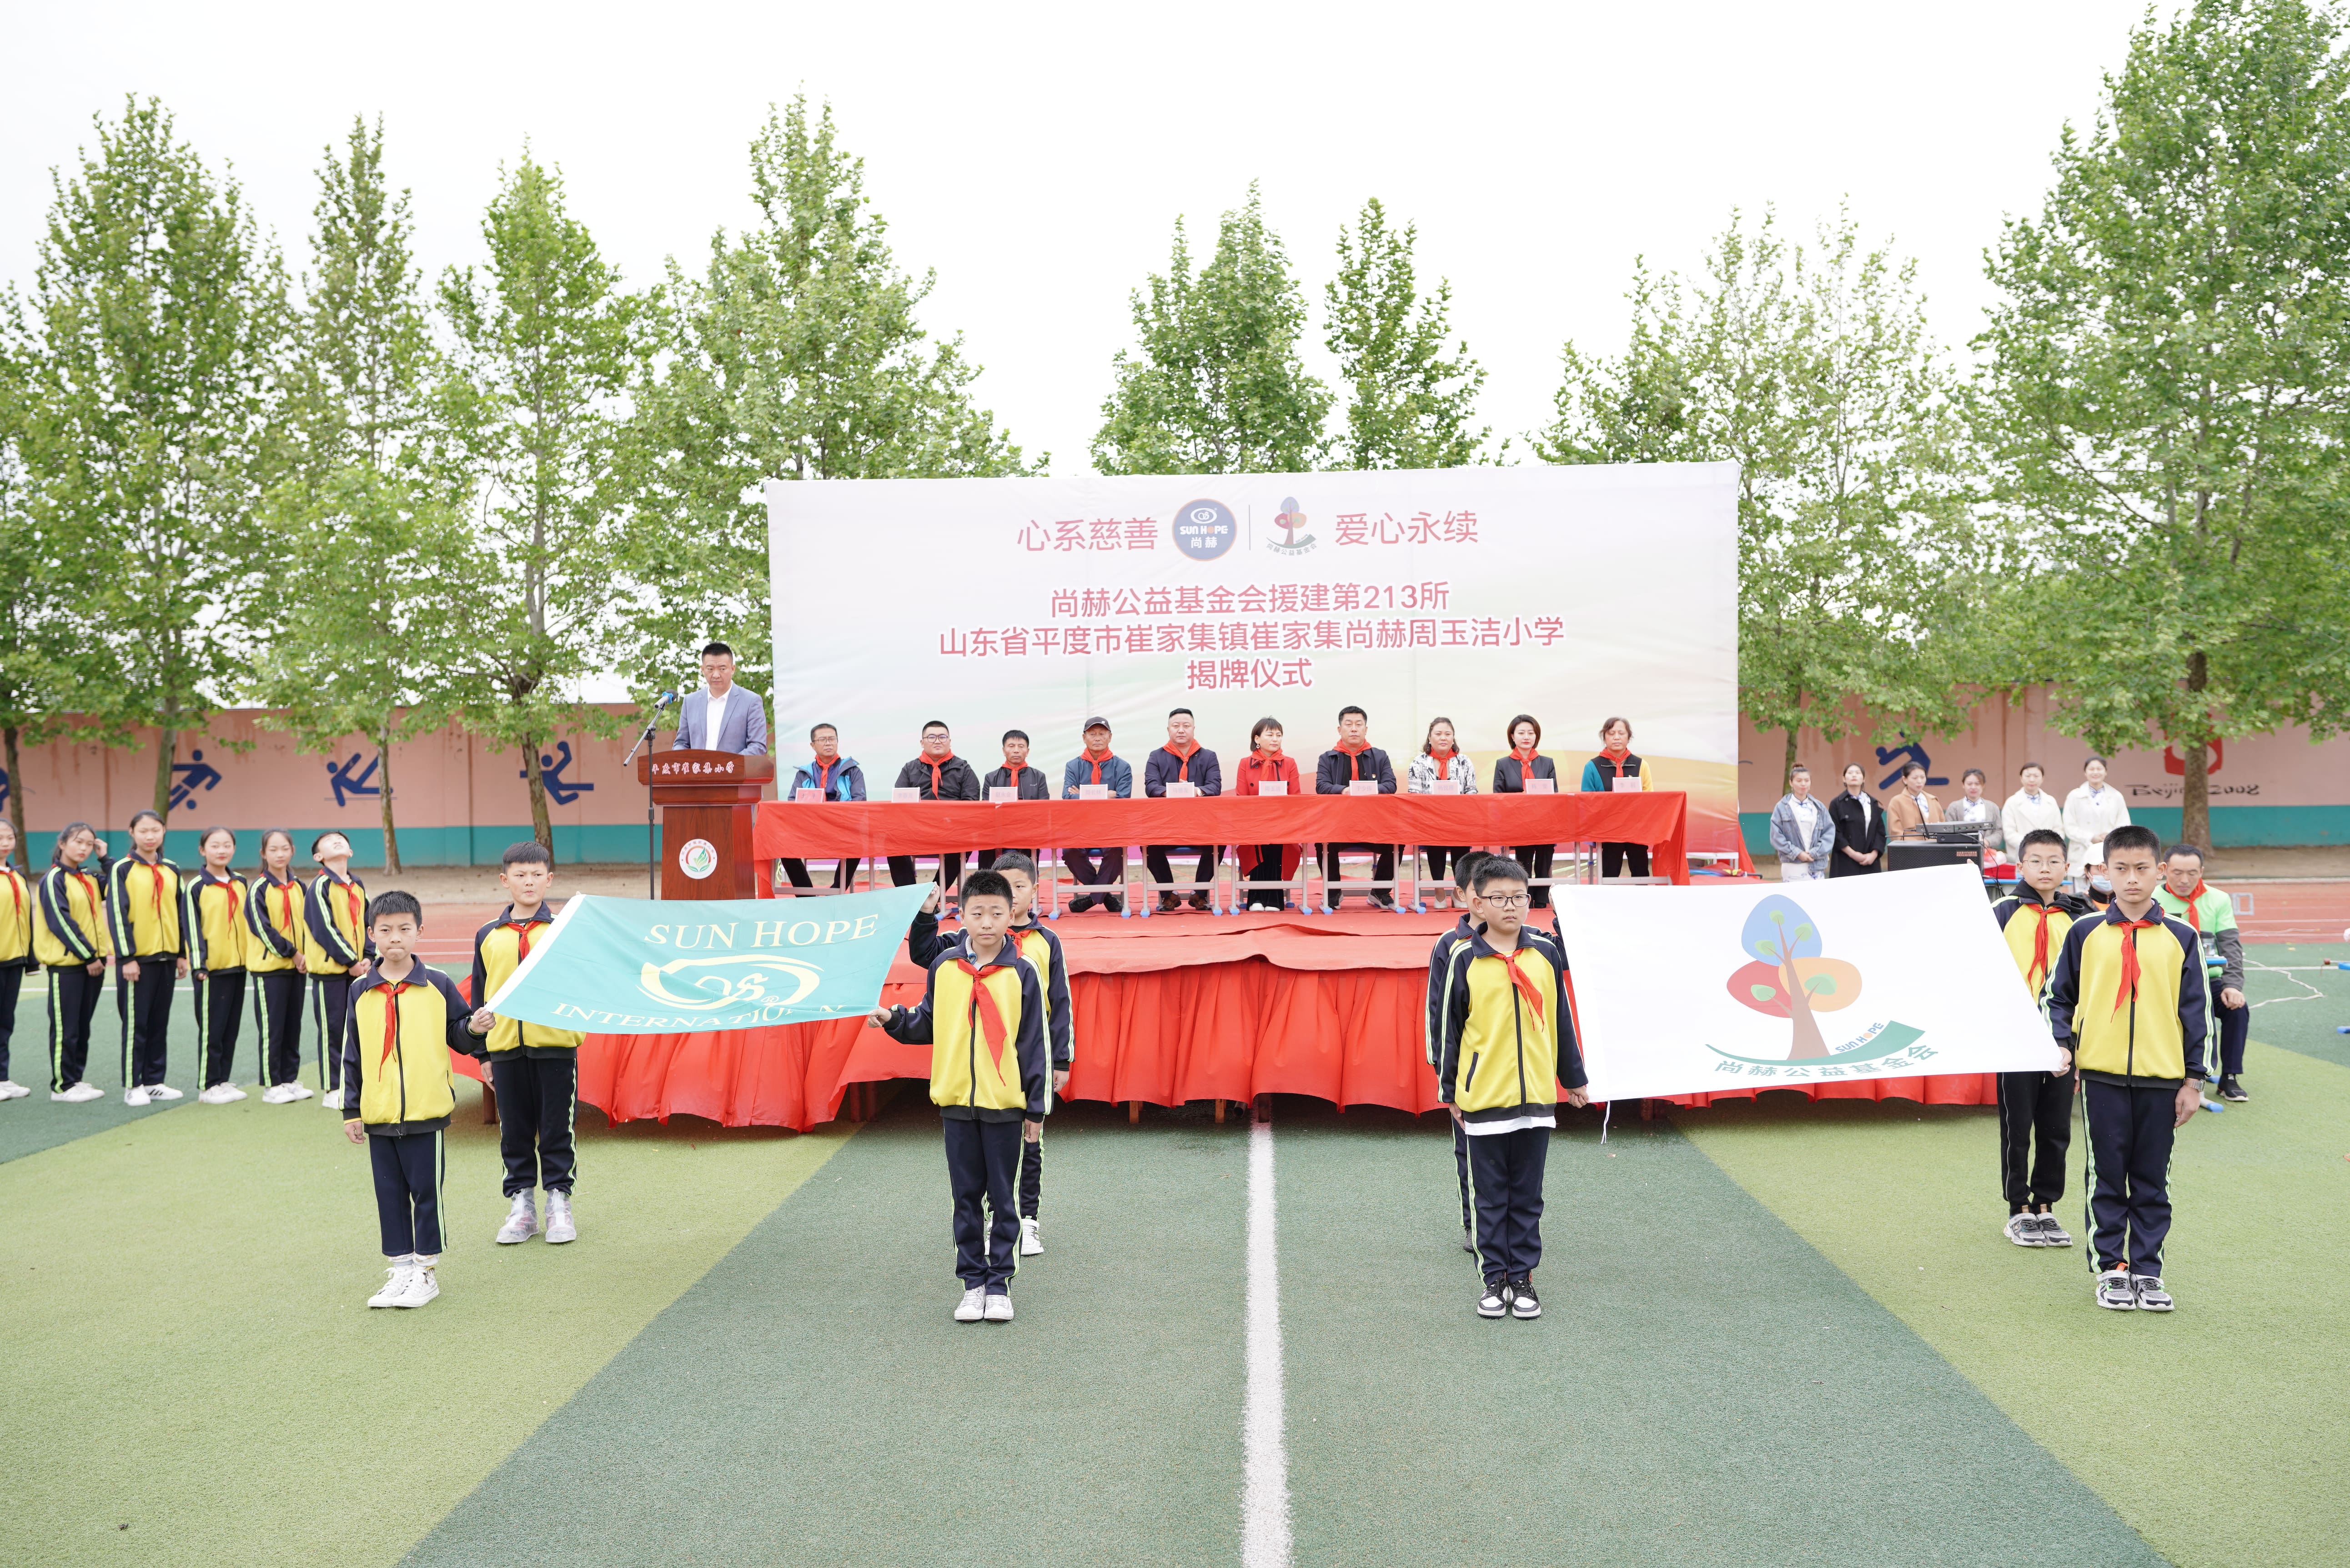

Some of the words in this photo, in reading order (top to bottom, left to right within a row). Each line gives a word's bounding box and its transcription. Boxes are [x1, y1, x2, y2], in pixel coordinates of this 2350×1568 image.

[1018, 518, 1158, 552] 心系慈善
[1180, 526, 1198, 535] SUN
[1200, 525, 1228, 534] HOPE
[1190, 537, 1217, 548] 尚赫
[1336, 511, 1478, 546] 爱心永续
[1052, 582, 1449, 618] 尚赫公益基金会援建第213所
[940, 617, 1564, 657] 山东省平度市崔家集镇崔家集尚赫周玉洁小学
[1187, 658, 1312, 689] 揭牌仪式
[652, 761, 734, 774] 平度市崔家集小学
[644, 922, 738, 949] SUN
[751, 914, 878, 948] HOPE
[1835, 1040, 1859, 1053] SUN
[1855, 1022, 1884, 1043] HOPE
[1715, 1044, 1938, 1077] 尚赫公益基金会
